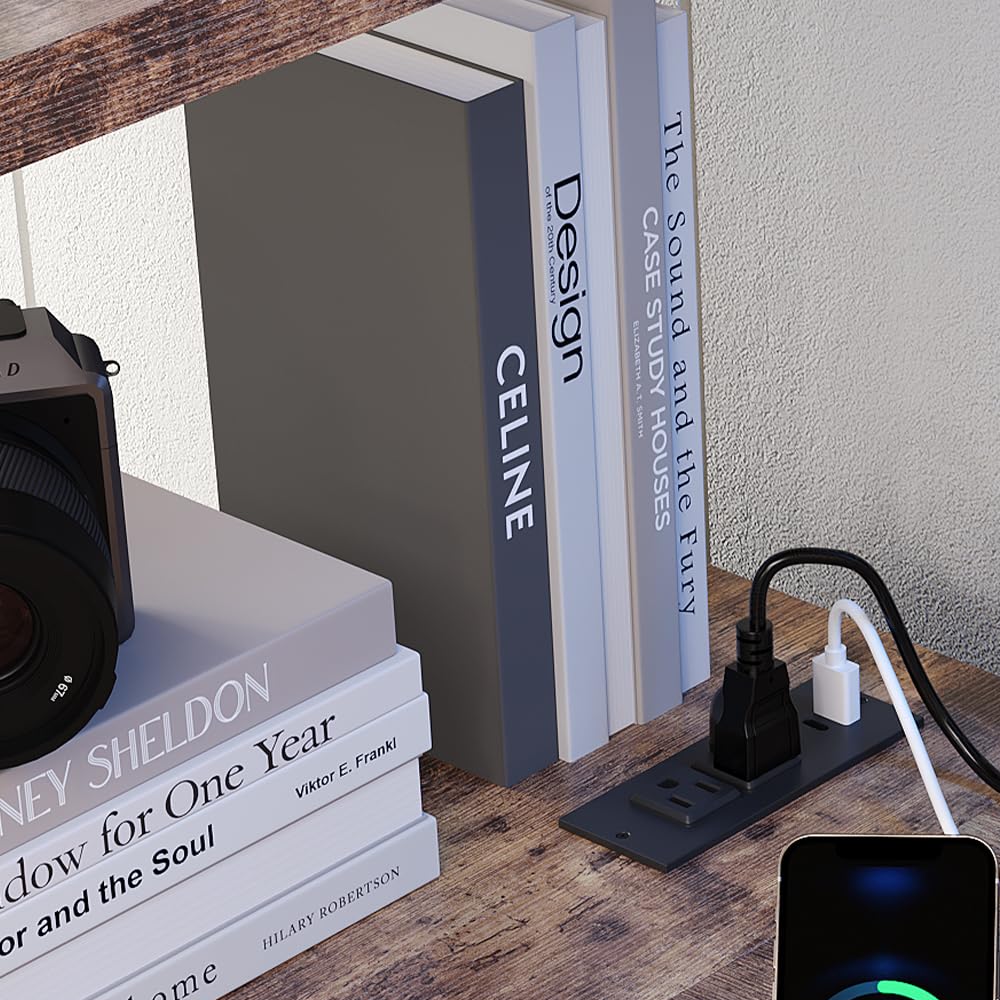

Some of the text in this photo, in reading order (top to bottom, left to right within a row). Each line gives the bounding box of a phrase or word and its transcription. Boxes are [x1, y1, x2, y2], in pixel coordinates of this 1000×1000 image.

[545, 185, 552, 198] of
[545, 201, 553, 222] the
[548, 256, 556, 304] Century
[552, 173, 586, 384] Design
[633, 320, 641, 380] ELIZABETH
[643, 206, 671, 532] CASE STUDY HOUSES
[664, 111, 698, 615] The Sound and the Fury
[496, 345, 534, 540] CELINE
[636, 405, 644, 438] SMITH
[0, 662, 270, 836] NEY SHELDON
[295, 737, 397, 799] Viktor E. Frankl
[0, 714, 336, 909] dow for One Year
[37, 889, 90, 937] and
[98, 869, 143, 904] the
[152, 824, 215, 876] Soul
[262, 866, 401, 950] HILARY ROBERTSON
